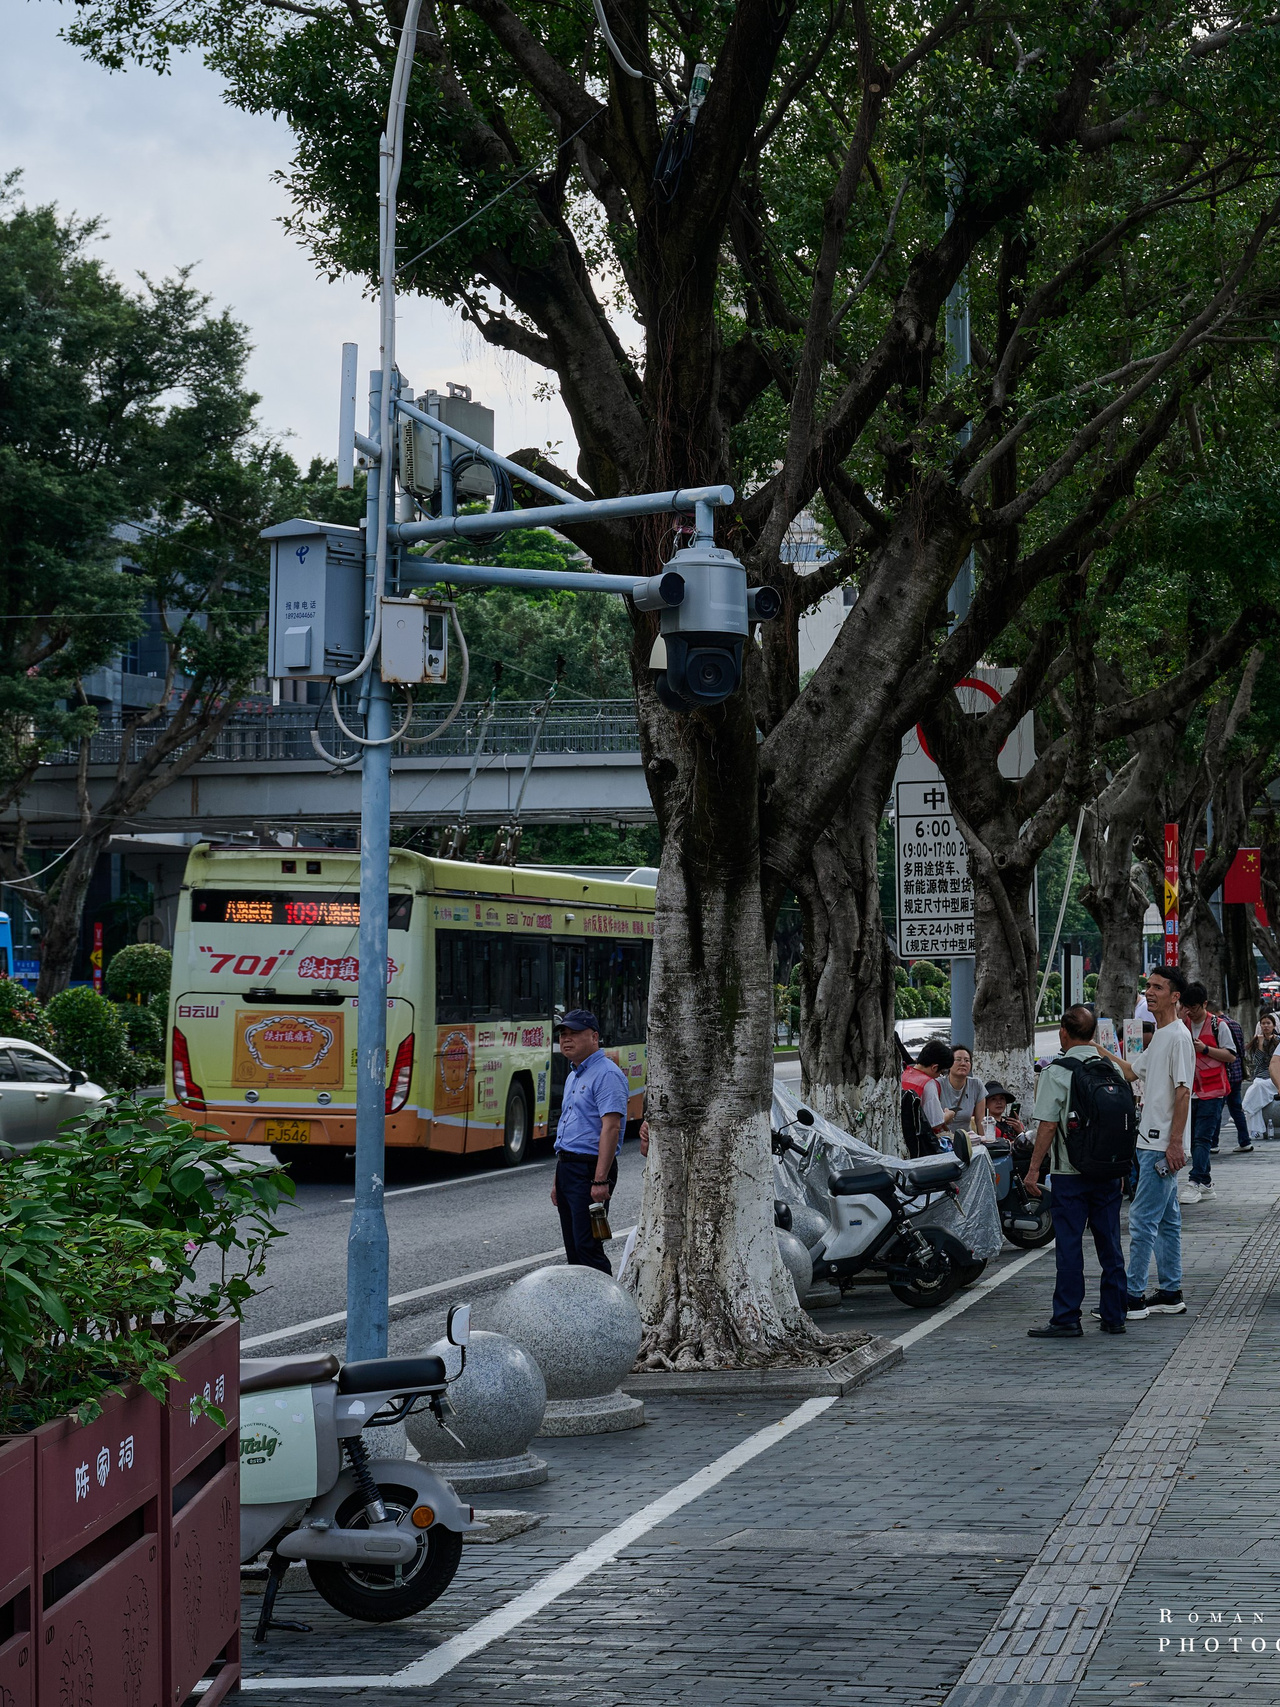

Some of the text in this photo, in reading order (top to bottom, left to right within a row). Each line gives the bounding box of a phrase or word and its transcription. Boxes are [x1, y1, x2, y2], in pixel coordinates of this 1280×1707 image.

[286, 600, 316, 610] 报障电话
[924, 788, 945, 810] 中
[916, 820, 950, 838] 6:00
[903, 842, 956, 858] (9:00-17:00
[904, 878, 974, 895] 新能源微型货
[284, 901, 318, 924] 109
[178, 1005, 219, 1018] 白云山
[266, 1128, 307, 1142] FJ546
[75, 1435, 134, 1503] 陈家祠
